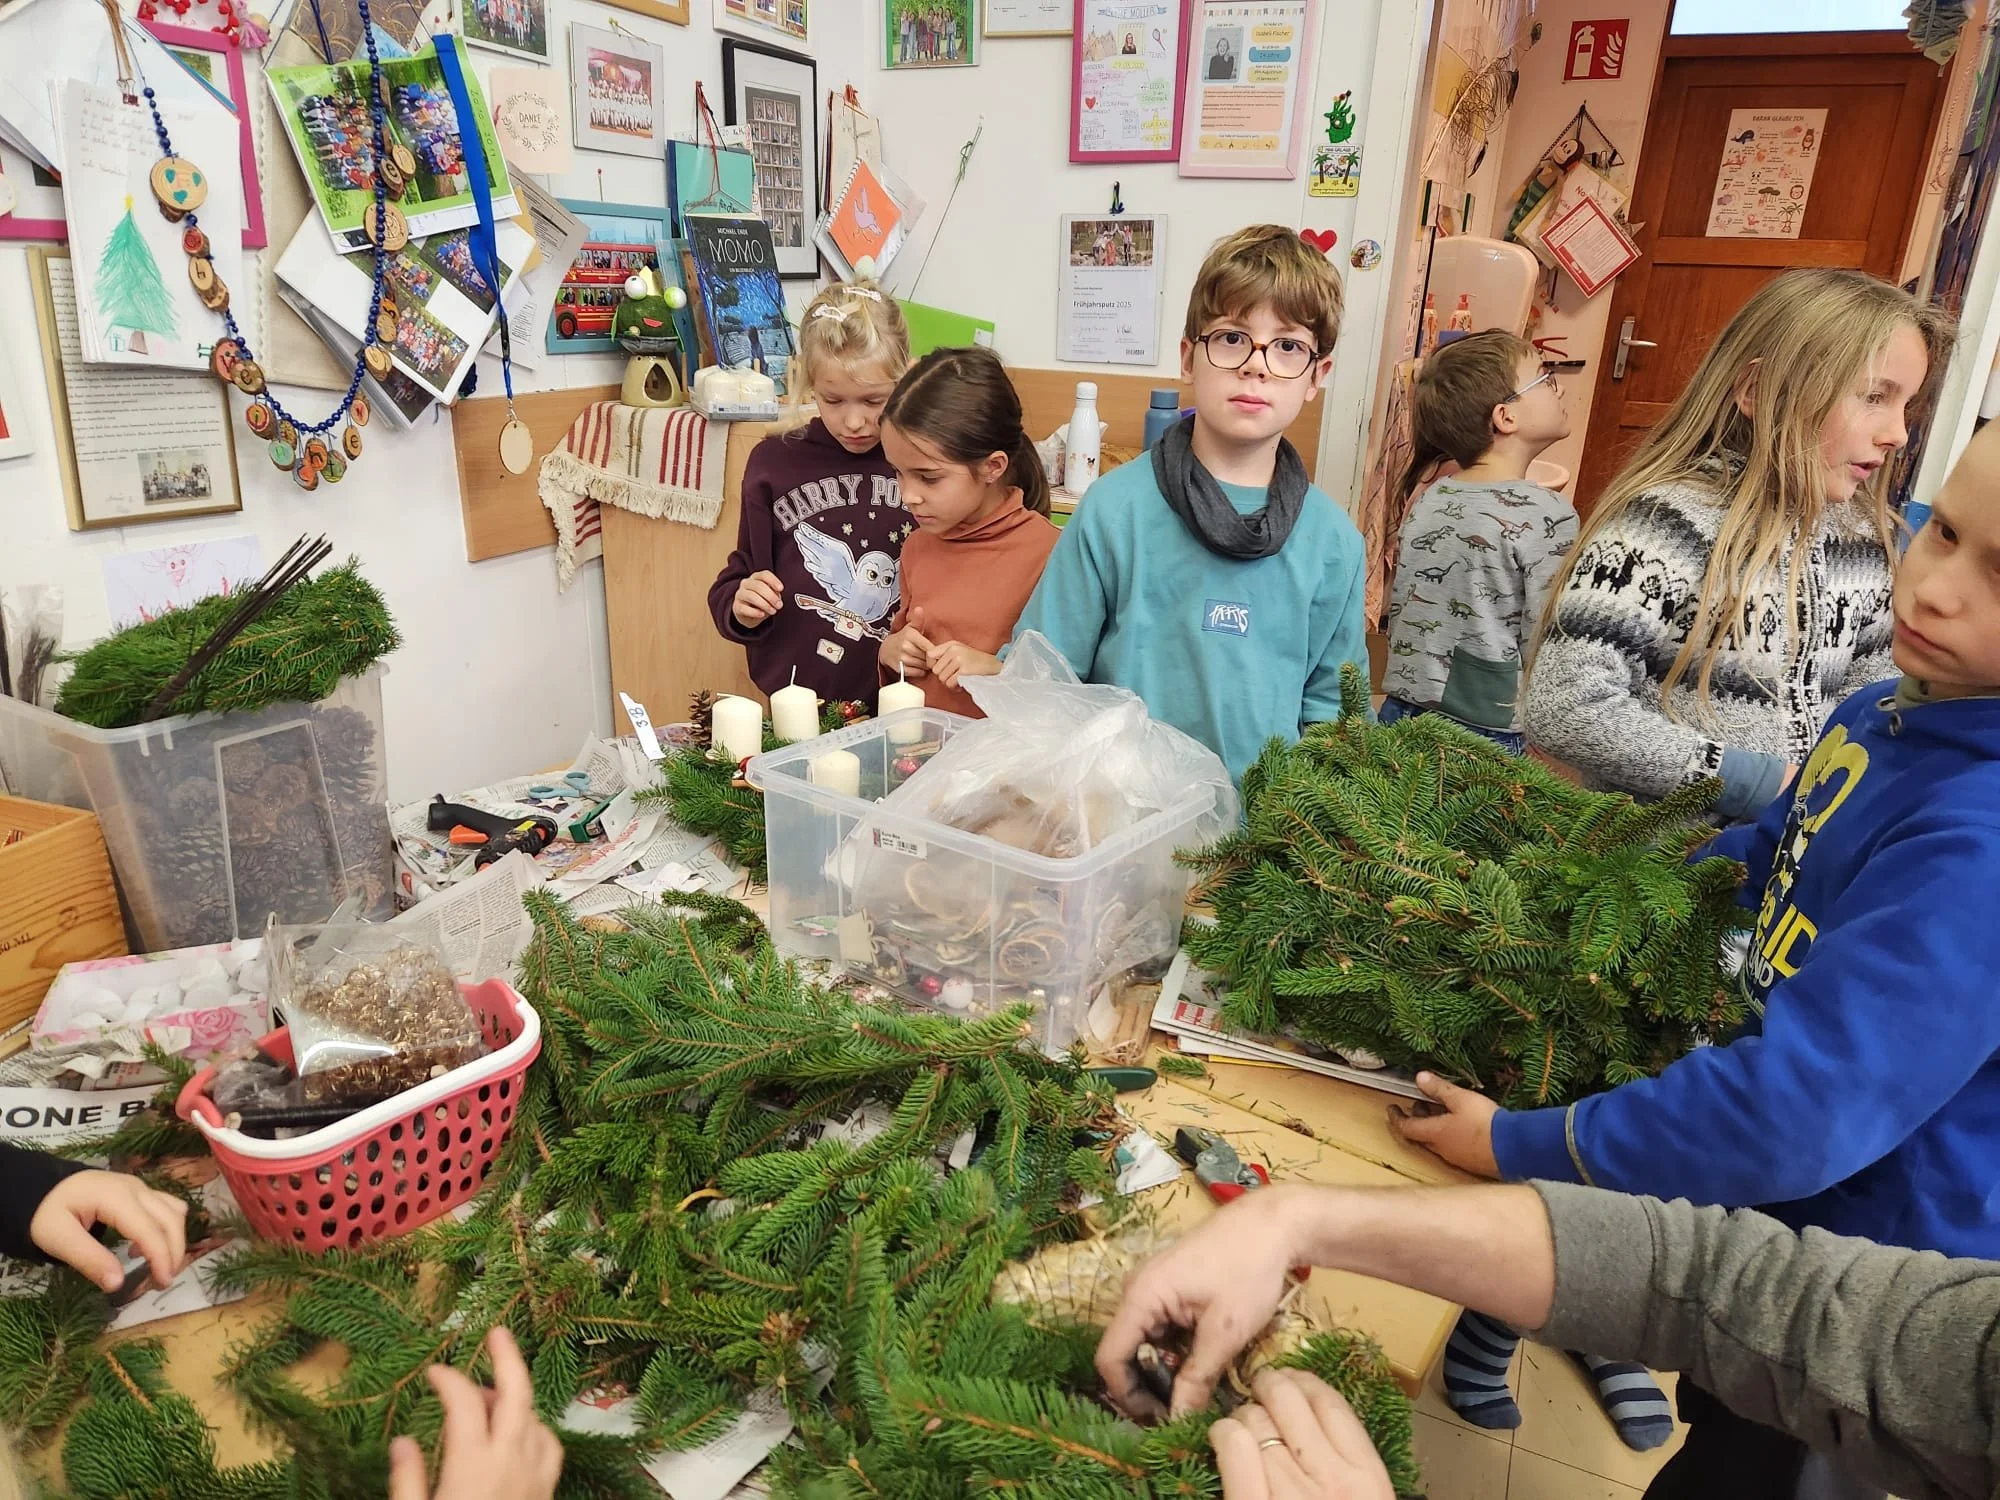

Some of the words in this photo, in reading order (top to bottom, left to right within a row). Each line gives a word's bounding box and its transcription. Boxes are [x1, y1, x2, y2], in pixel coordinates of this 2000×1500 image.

[519, 112, 540, 123] DANKE
[717, 227, 737, 236] MICHAEL
[708, 237, 764, 264] MOMO
[1073, 300, 1115, 310] Frühjahrsputz
[1116, 300, 1132, 308] 2025
[773, 473, 864, 532] HARRY
[870, 474, 911, 512] PO
[0, 1105, 104, 1129] ONE
